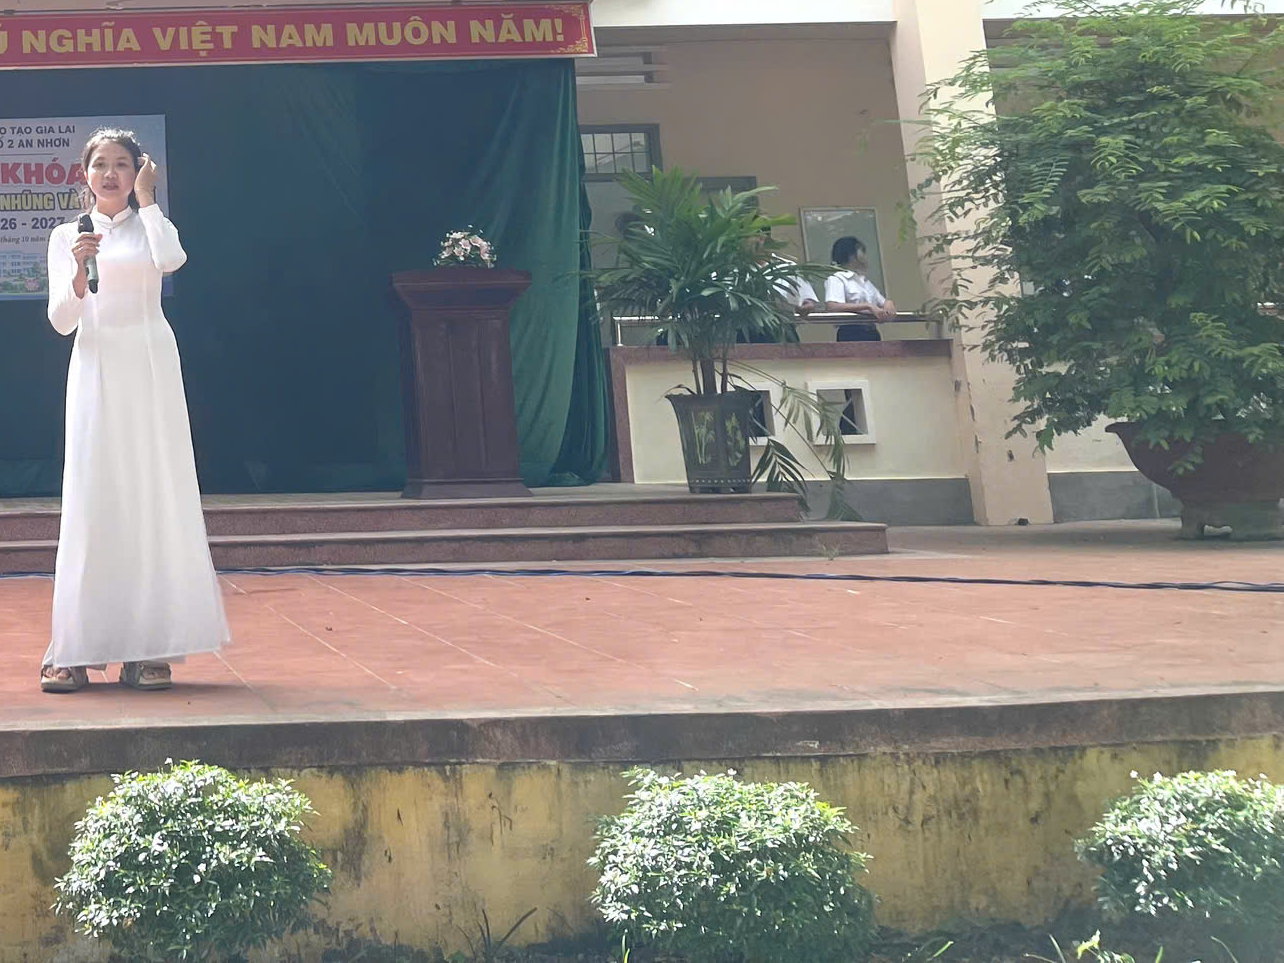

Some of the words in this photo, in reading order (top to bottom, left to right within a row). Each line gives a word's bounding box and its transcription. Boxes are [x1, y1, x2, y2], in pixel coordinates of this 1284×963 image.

[22, 21, 141, 54] NGHĨA
[152, 20, 238, 57] VIỆT
[251, 24, 334, 48] NAM
[346, 15, 457, 46] MUÔN
[469, 13, 564, 44] NĂM!
[10, 125, 32, 137] TẠO
[35, 125, 55, 134] GIA
[58, 125, 76, 134] LAI
[7, 139, 15, 149] 2
[17, 139, 34, 148] AN
[37, 137, 70, 148] NHƠN
[0, 190, 59, 212] NHŨNG
[59, 189, 81, 210] VÀ
